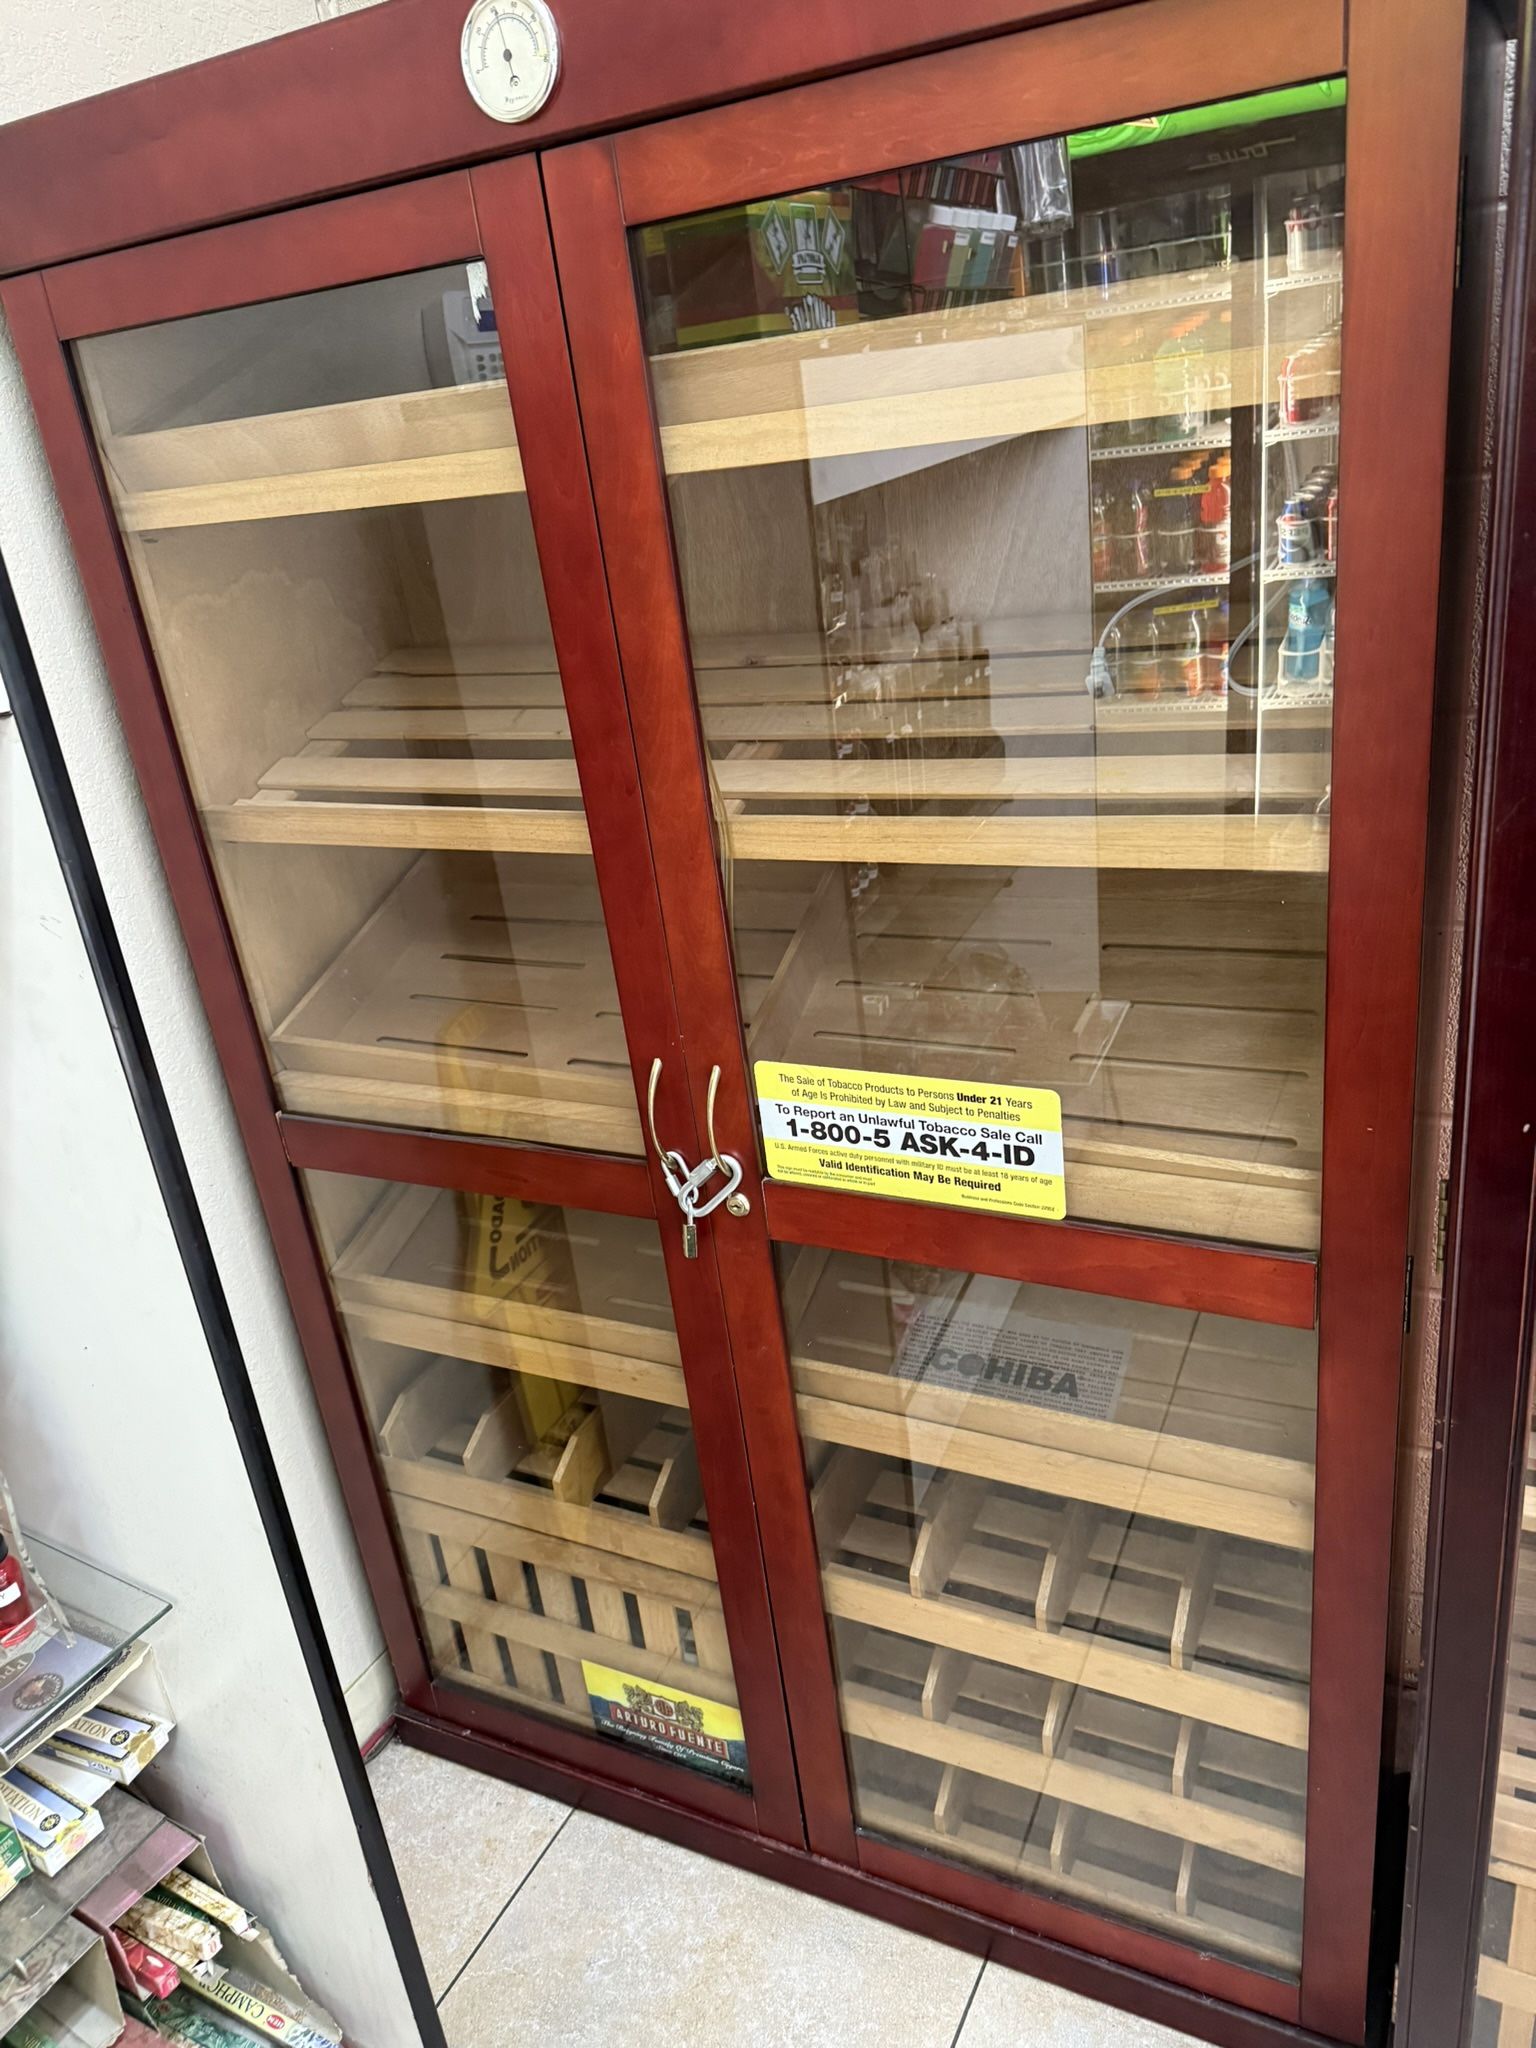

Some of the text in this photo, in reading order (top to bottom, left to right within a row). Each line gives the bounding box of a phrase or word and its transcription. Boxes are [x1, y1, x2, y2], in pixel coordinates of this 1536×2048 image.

[778, 1073, 1033, 1110] The Sale of Tobacco Products to Persons Under 21 Years
[791, 1087, 1021, 1122] of Age Is Prohibited by Law and Subject to Penalties
[774, 1103, 1043, 1145] To Report an Unlawful Tobacco Sale Call
[785, 1117, 1036, 1168] 1-800-5 ASK-4-ID
[774, 1141, 787, 1150] U.S.
[786, 1143, 808, 1153] Armed
[807, 1145, 829, 1156] Forces
[829, 1149, 848, 1158] active
[848, 1151, 863, 1161] duty
[863, 1153, 895, 1165] personnel
[895, 1158, 910, 1166] with
[910, 1159, 936, 1171] military
[936, 1163, 944, 1171] ID
[944, 1164, 962, 1173] must
[963, 1166, 973, 1175] be
[973, 1168, 981, 1176] at
[981, 1168, 999, 1178] least
[1009, 1173, 1029, 1184] years
[1030, 1175, 1038, 1184] of
[1039, 1177, 1053, 1187] age
[818, 1157, 1001, 1194] Valid Identification May Be Required
[931, 1347, 1080, 1398] COHIBA
[69, 1716, 113, 1739] ATION
[616, 1708, 666, 1733] ARTURO
[669, 1725, 723, 1754] FUENTE
